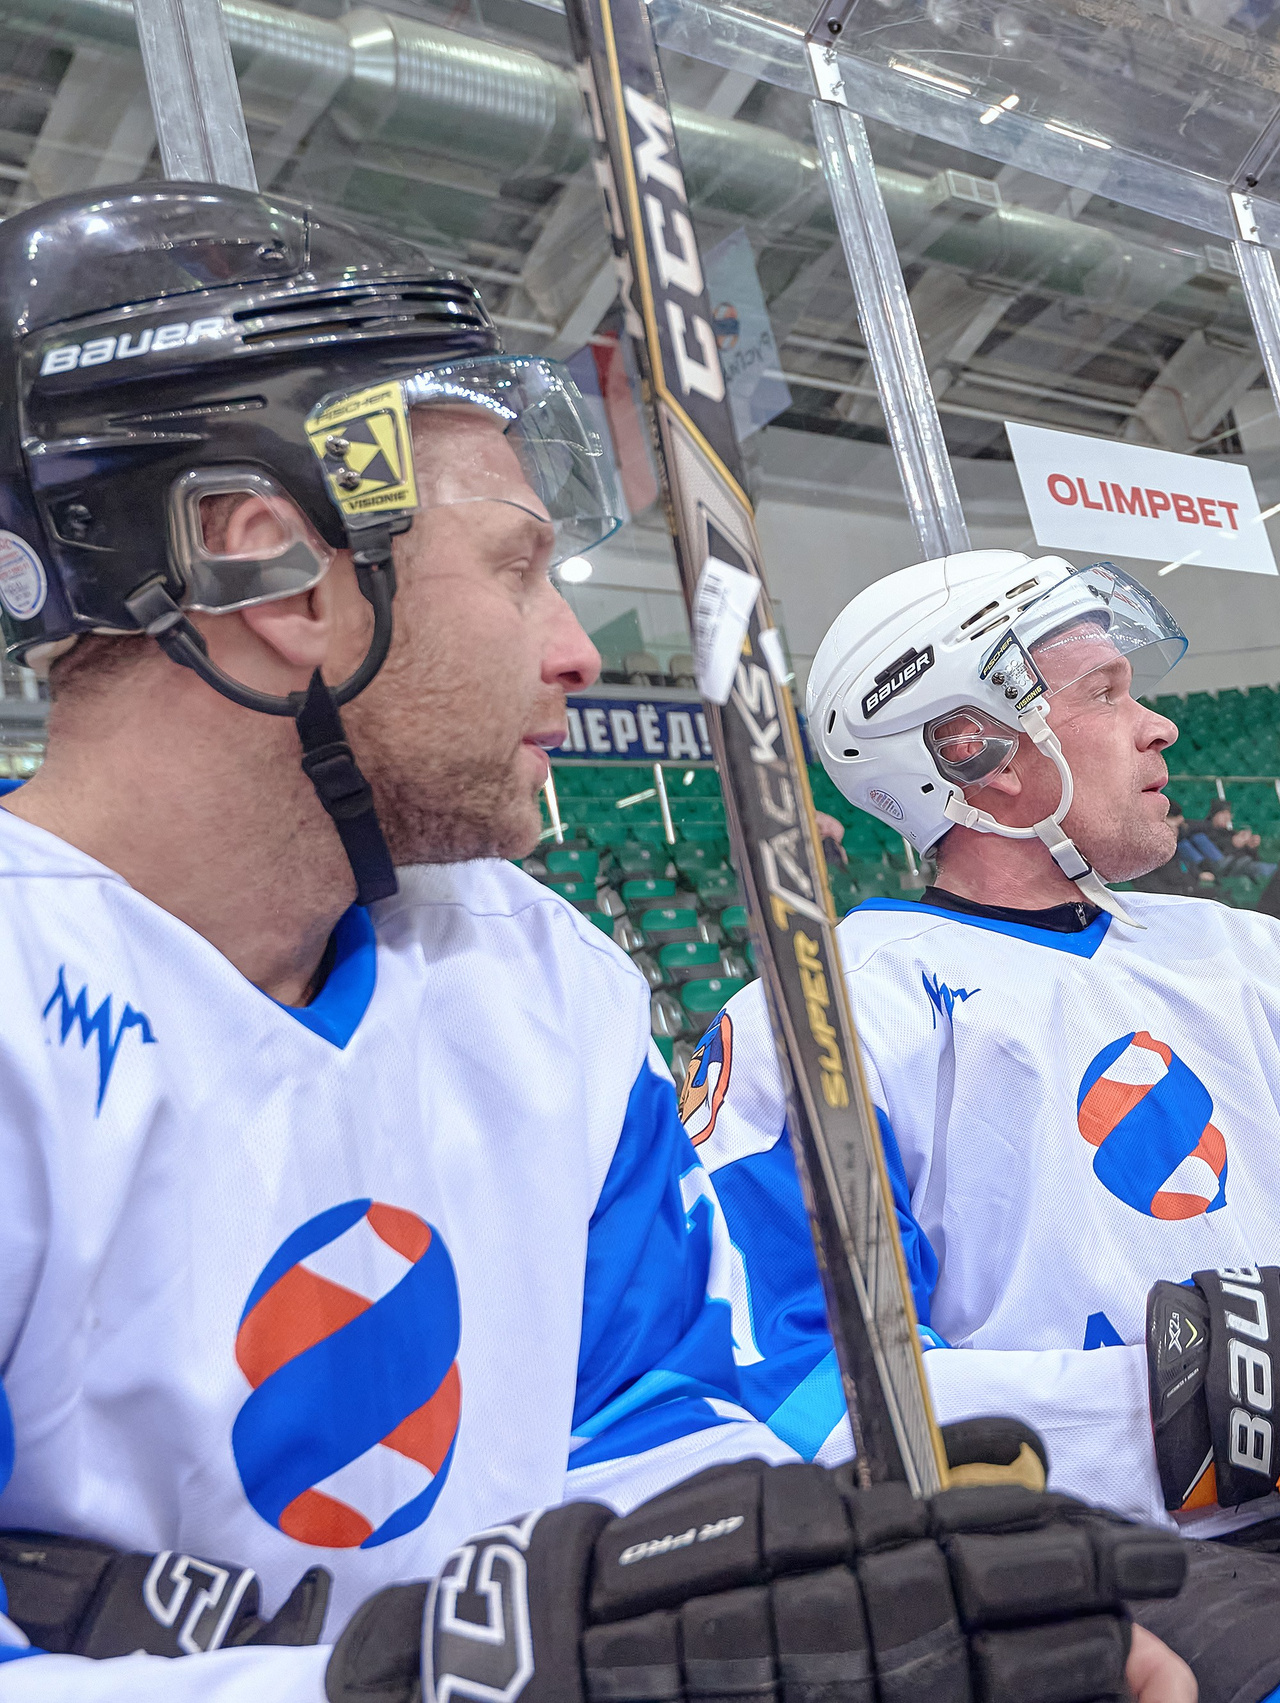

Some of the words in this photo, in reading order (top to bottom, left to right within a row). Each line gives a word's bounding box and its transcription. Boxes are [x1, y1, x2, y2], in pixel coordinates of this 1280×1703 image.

[625, 86, 726, 403] CCM
[1046, 472, 1240, 531] OLIMPBET
[982, 636, 1013, 676] FISCHER
[794, 930, 850, 1109] SUPER
